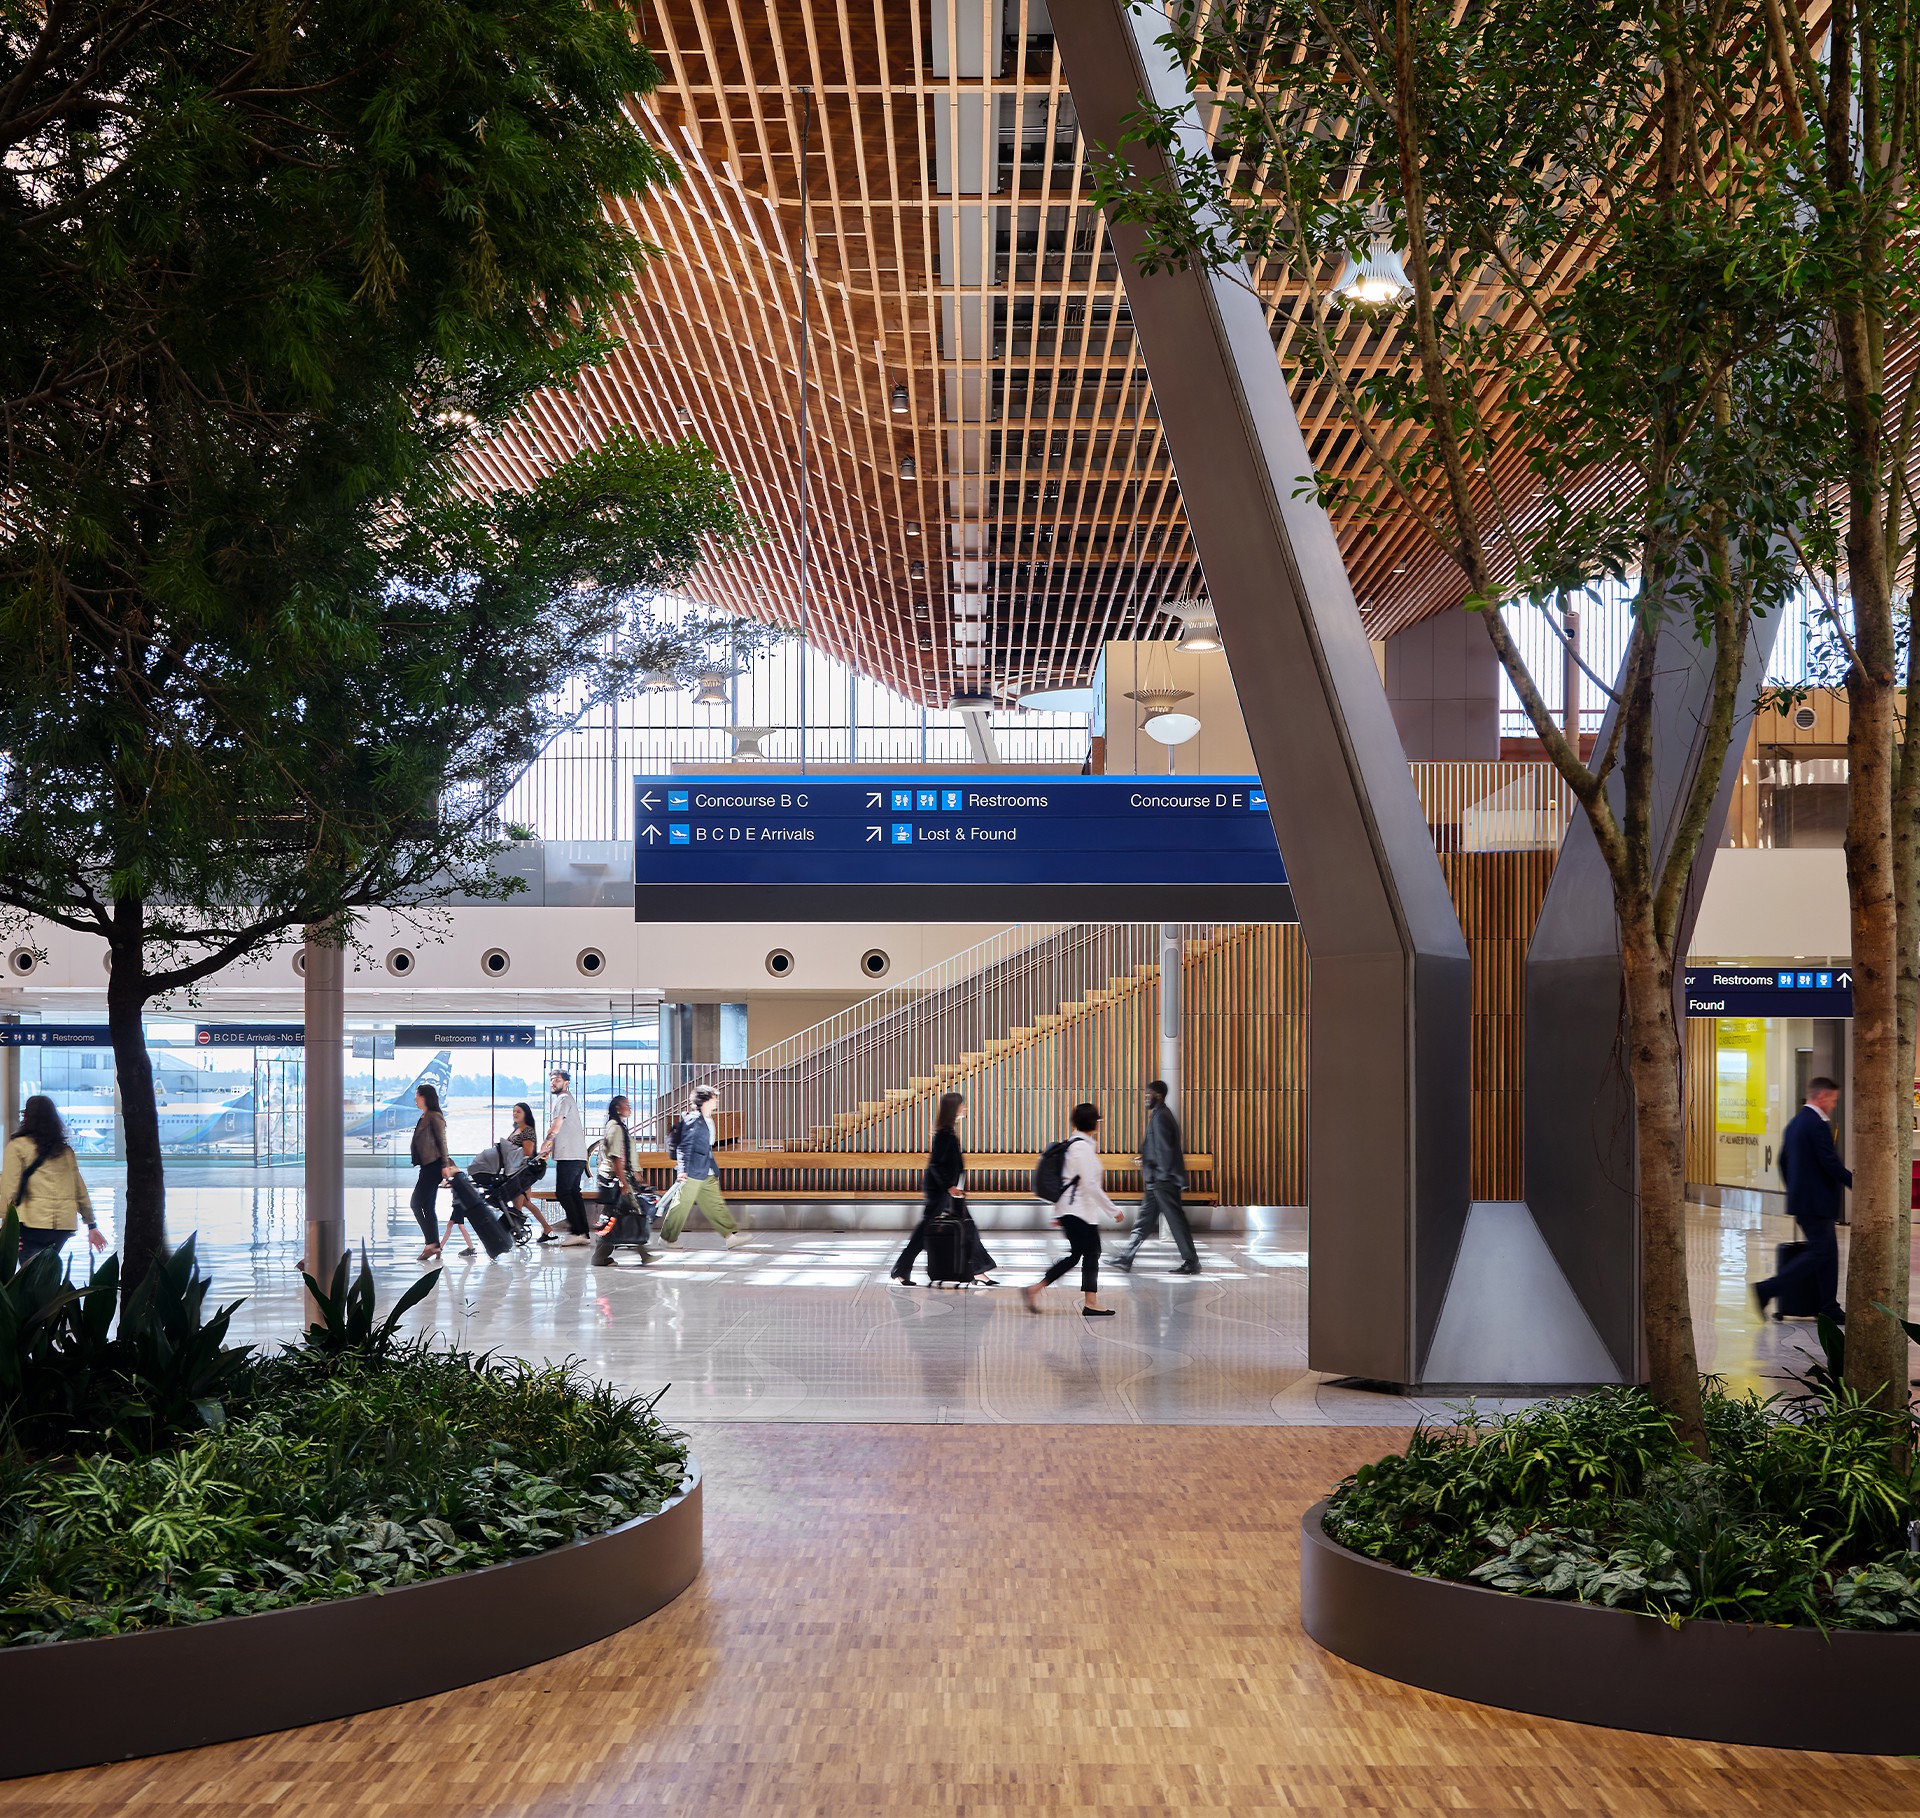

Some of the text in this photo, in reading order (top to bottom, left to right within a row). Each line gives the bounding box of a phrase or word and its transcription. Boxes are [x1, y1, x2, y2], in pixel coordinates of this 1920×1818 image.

[695, 793, 809, 808] Concourse B C
[969, 793, 1048, 808] Restrooms
[1130, 793, 1243, 808] Concourse D E
[696, 827, 815, 841] B C D E Arrivals
[918, 827, 1017, 841] Lost & Found
[1713, 974, 1774, 985] Restrooms
[1689, 999, 1725, 1010] Found
[52, 1033, 95, 1042] Restrooms
[246, 1033, 276, 1042] Arrivals
[281, 1033, 293, 1042] No
[434, 1034, 477, 1042] Restrooms
